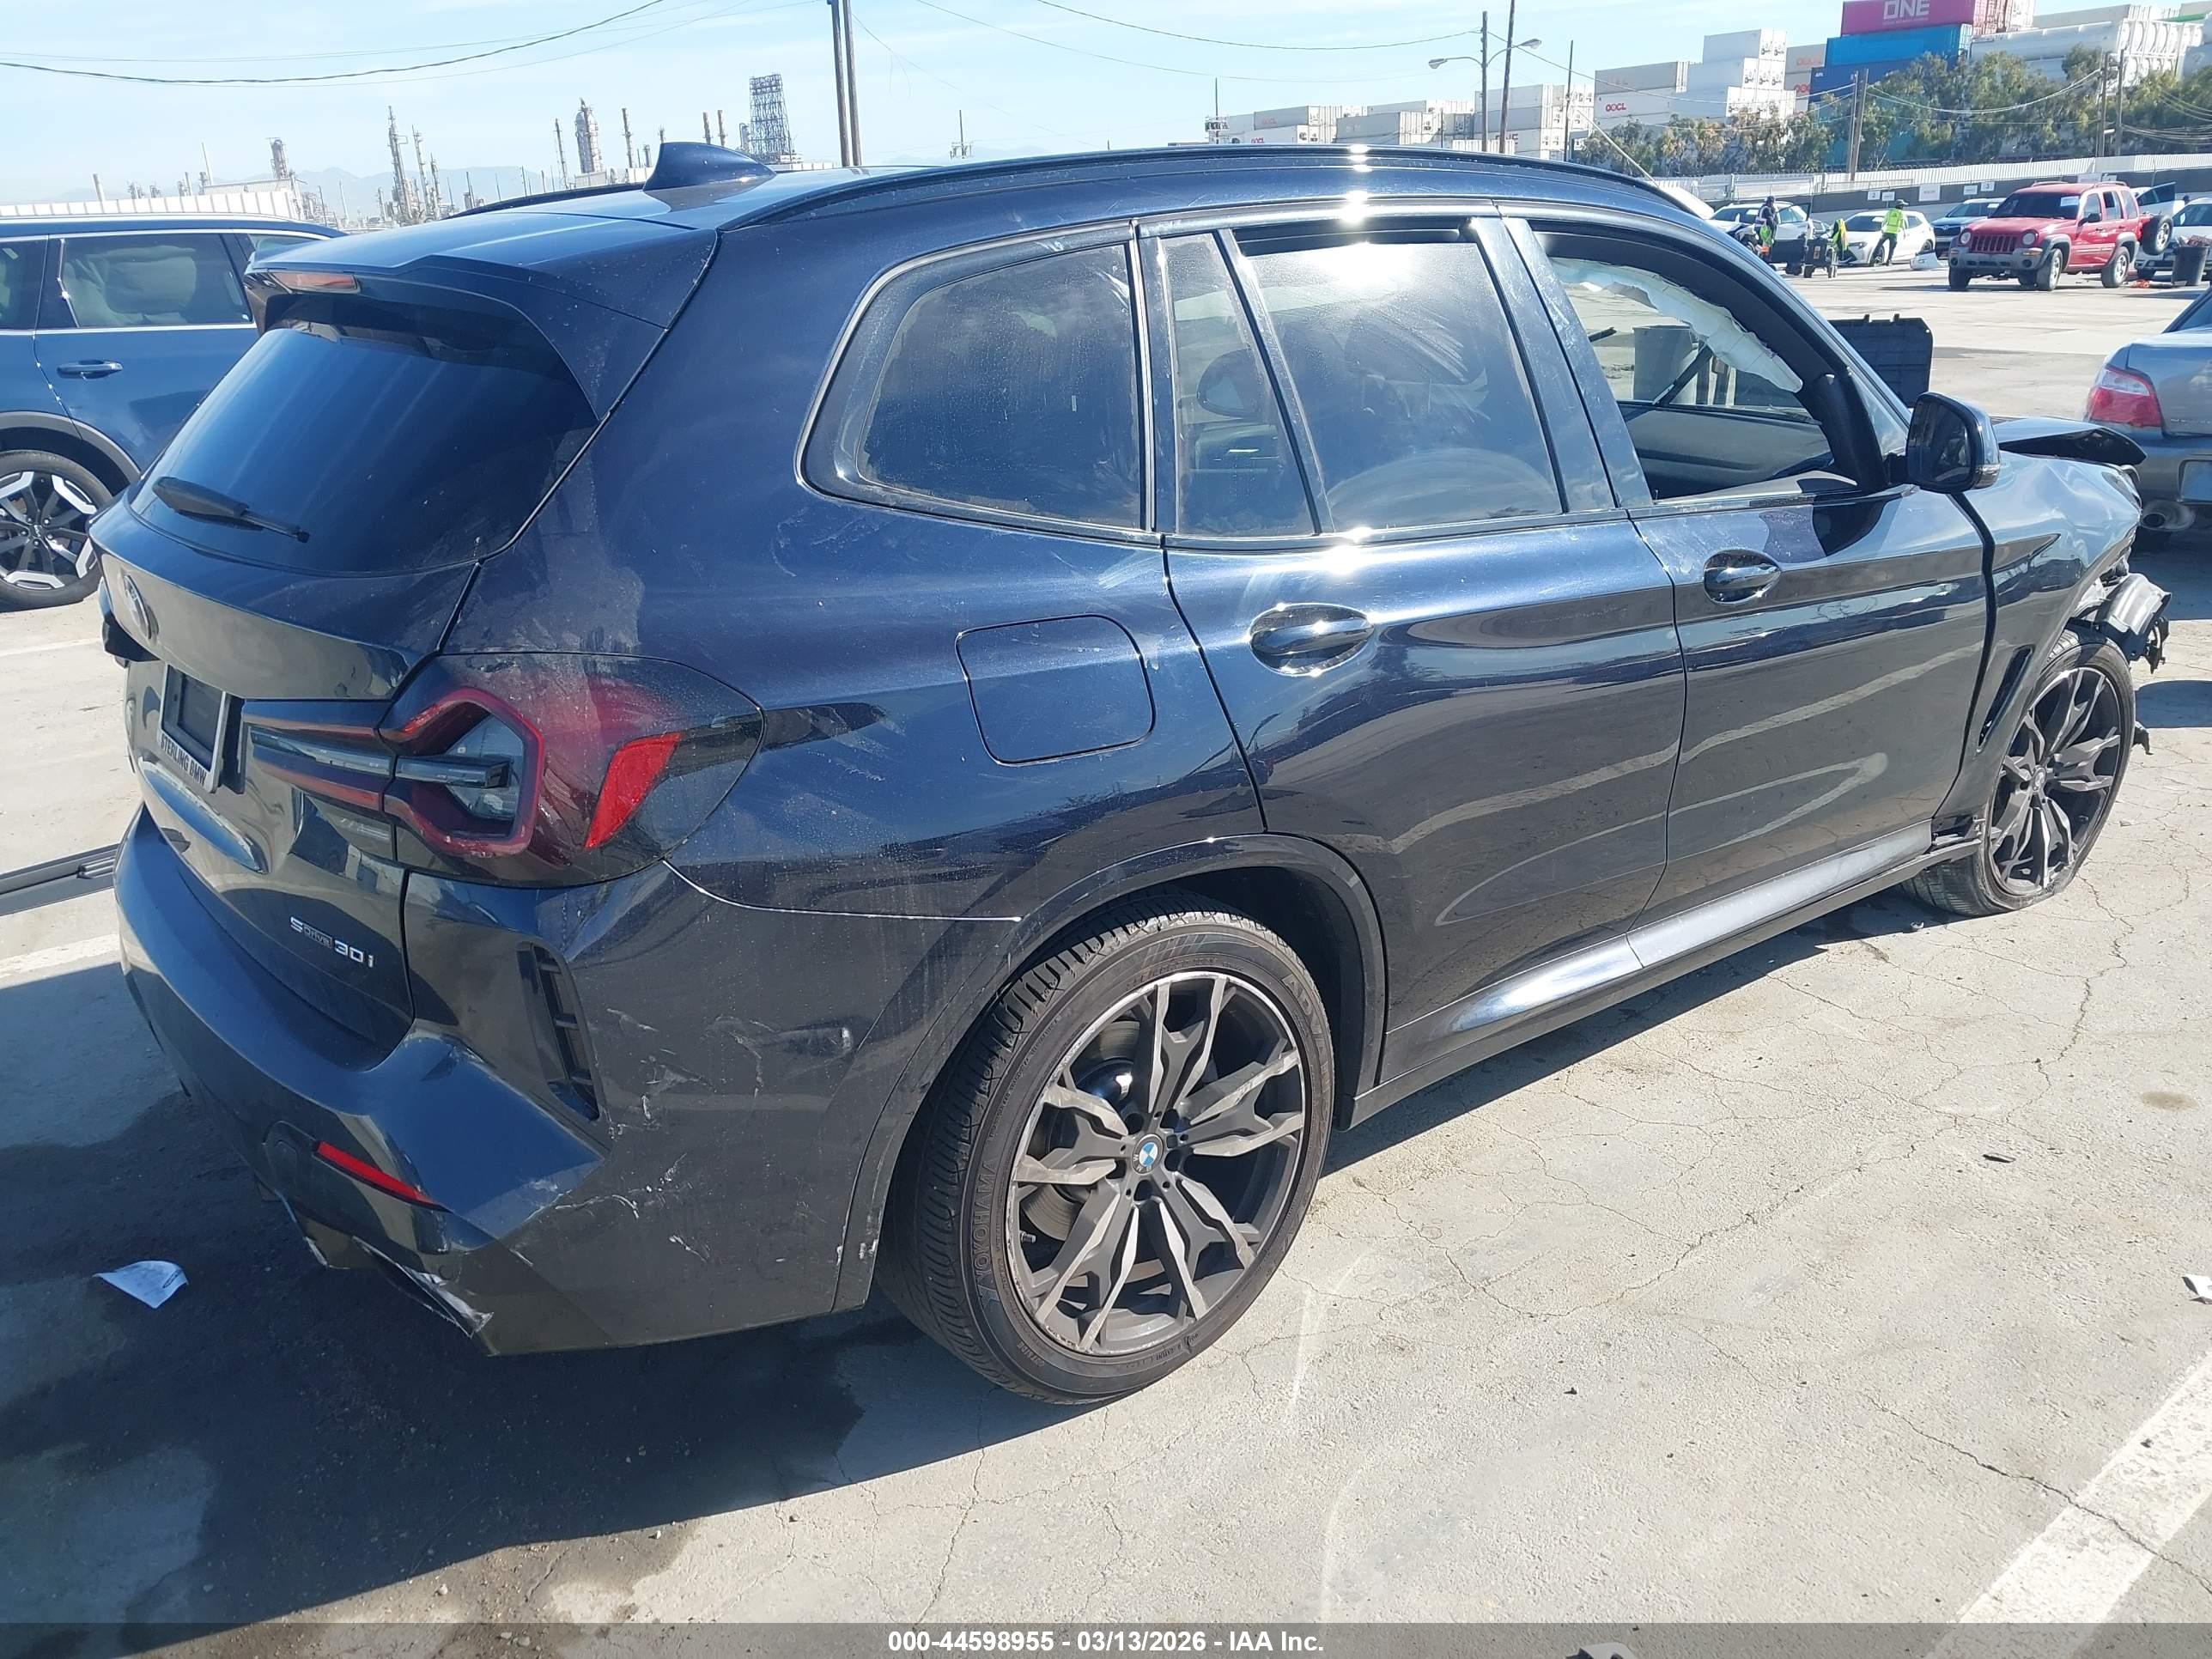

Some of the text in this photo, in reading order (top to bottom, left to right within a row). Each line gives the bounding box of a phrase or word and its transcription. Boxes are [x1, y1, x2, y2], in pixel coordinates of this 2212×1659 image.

[1883, 0, 1930, 20] ONE
[1606, 102, 1626, 112] OOCL
[161, 732, 208, 787] STERLING BMW
